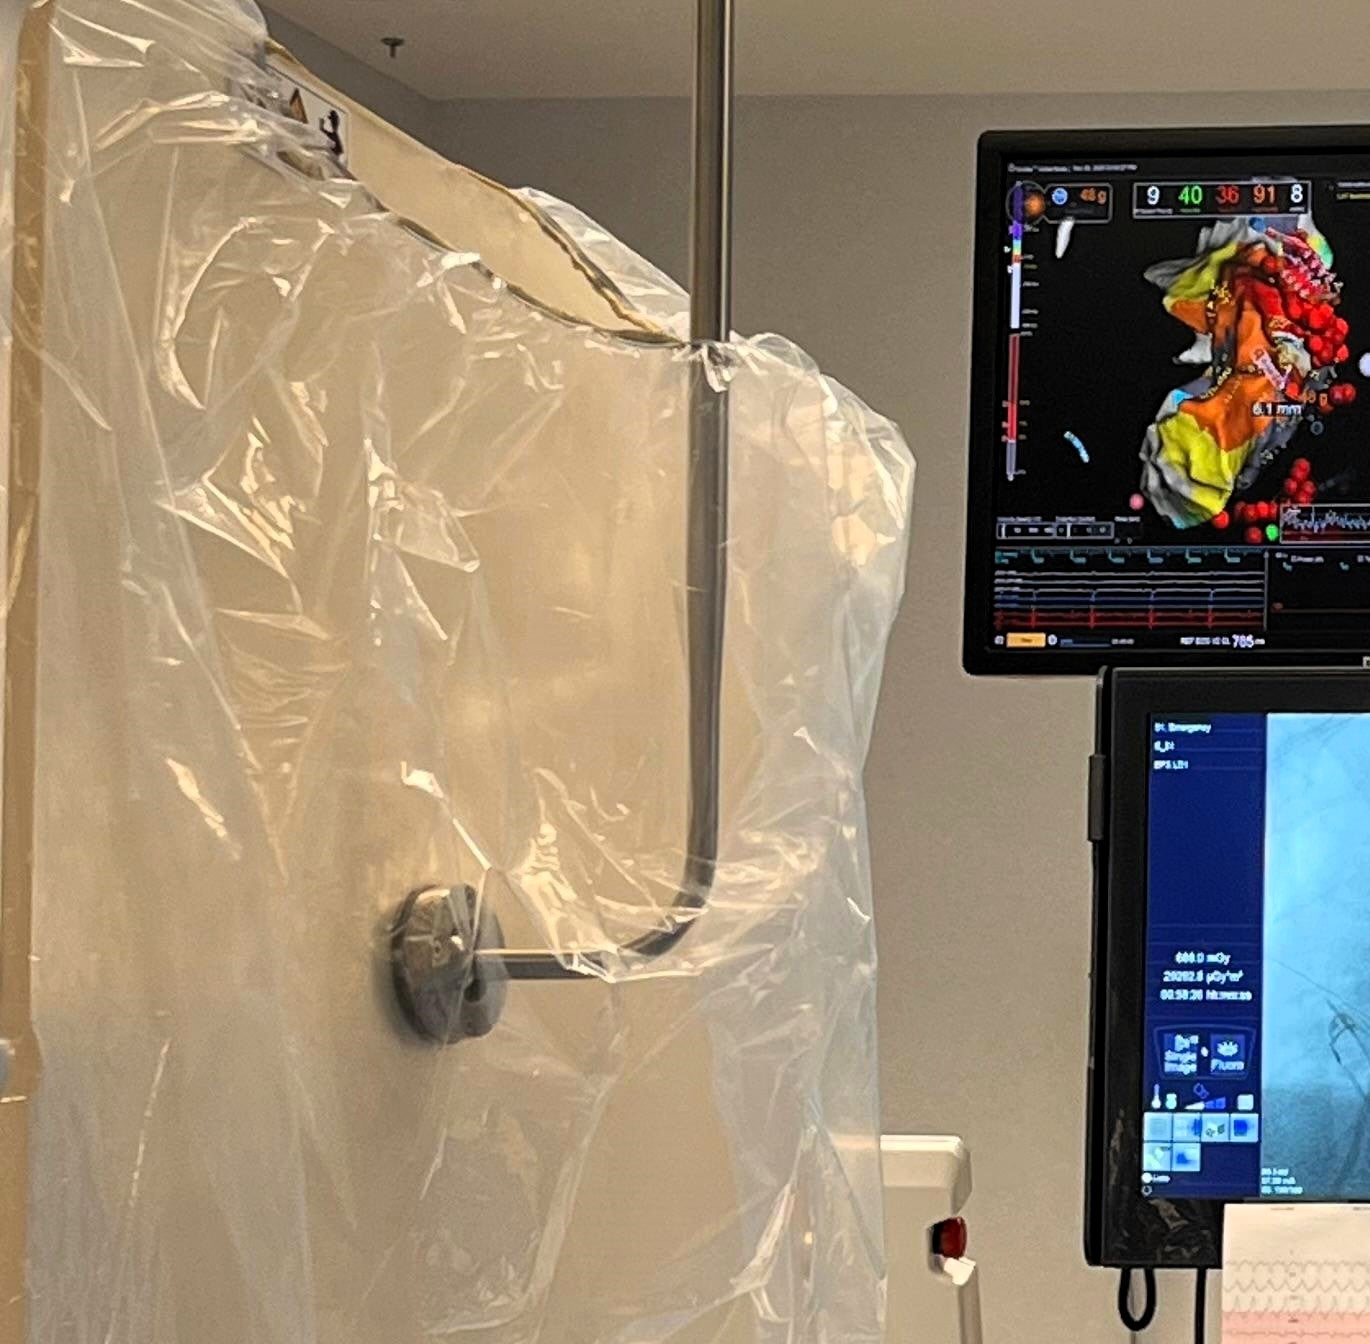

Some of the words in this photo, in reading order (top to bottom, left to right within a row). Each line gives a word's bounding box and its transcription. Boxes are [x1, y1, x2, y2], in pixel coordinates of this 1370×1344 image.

[1147, 185, 1160, 205] 9
[1178, 184, 1202, 204] 40
[1215, 185, 1240, 204] 36
[1253, 184, 1276, 204] 91
[1290, 184, 1303, 203] 8
